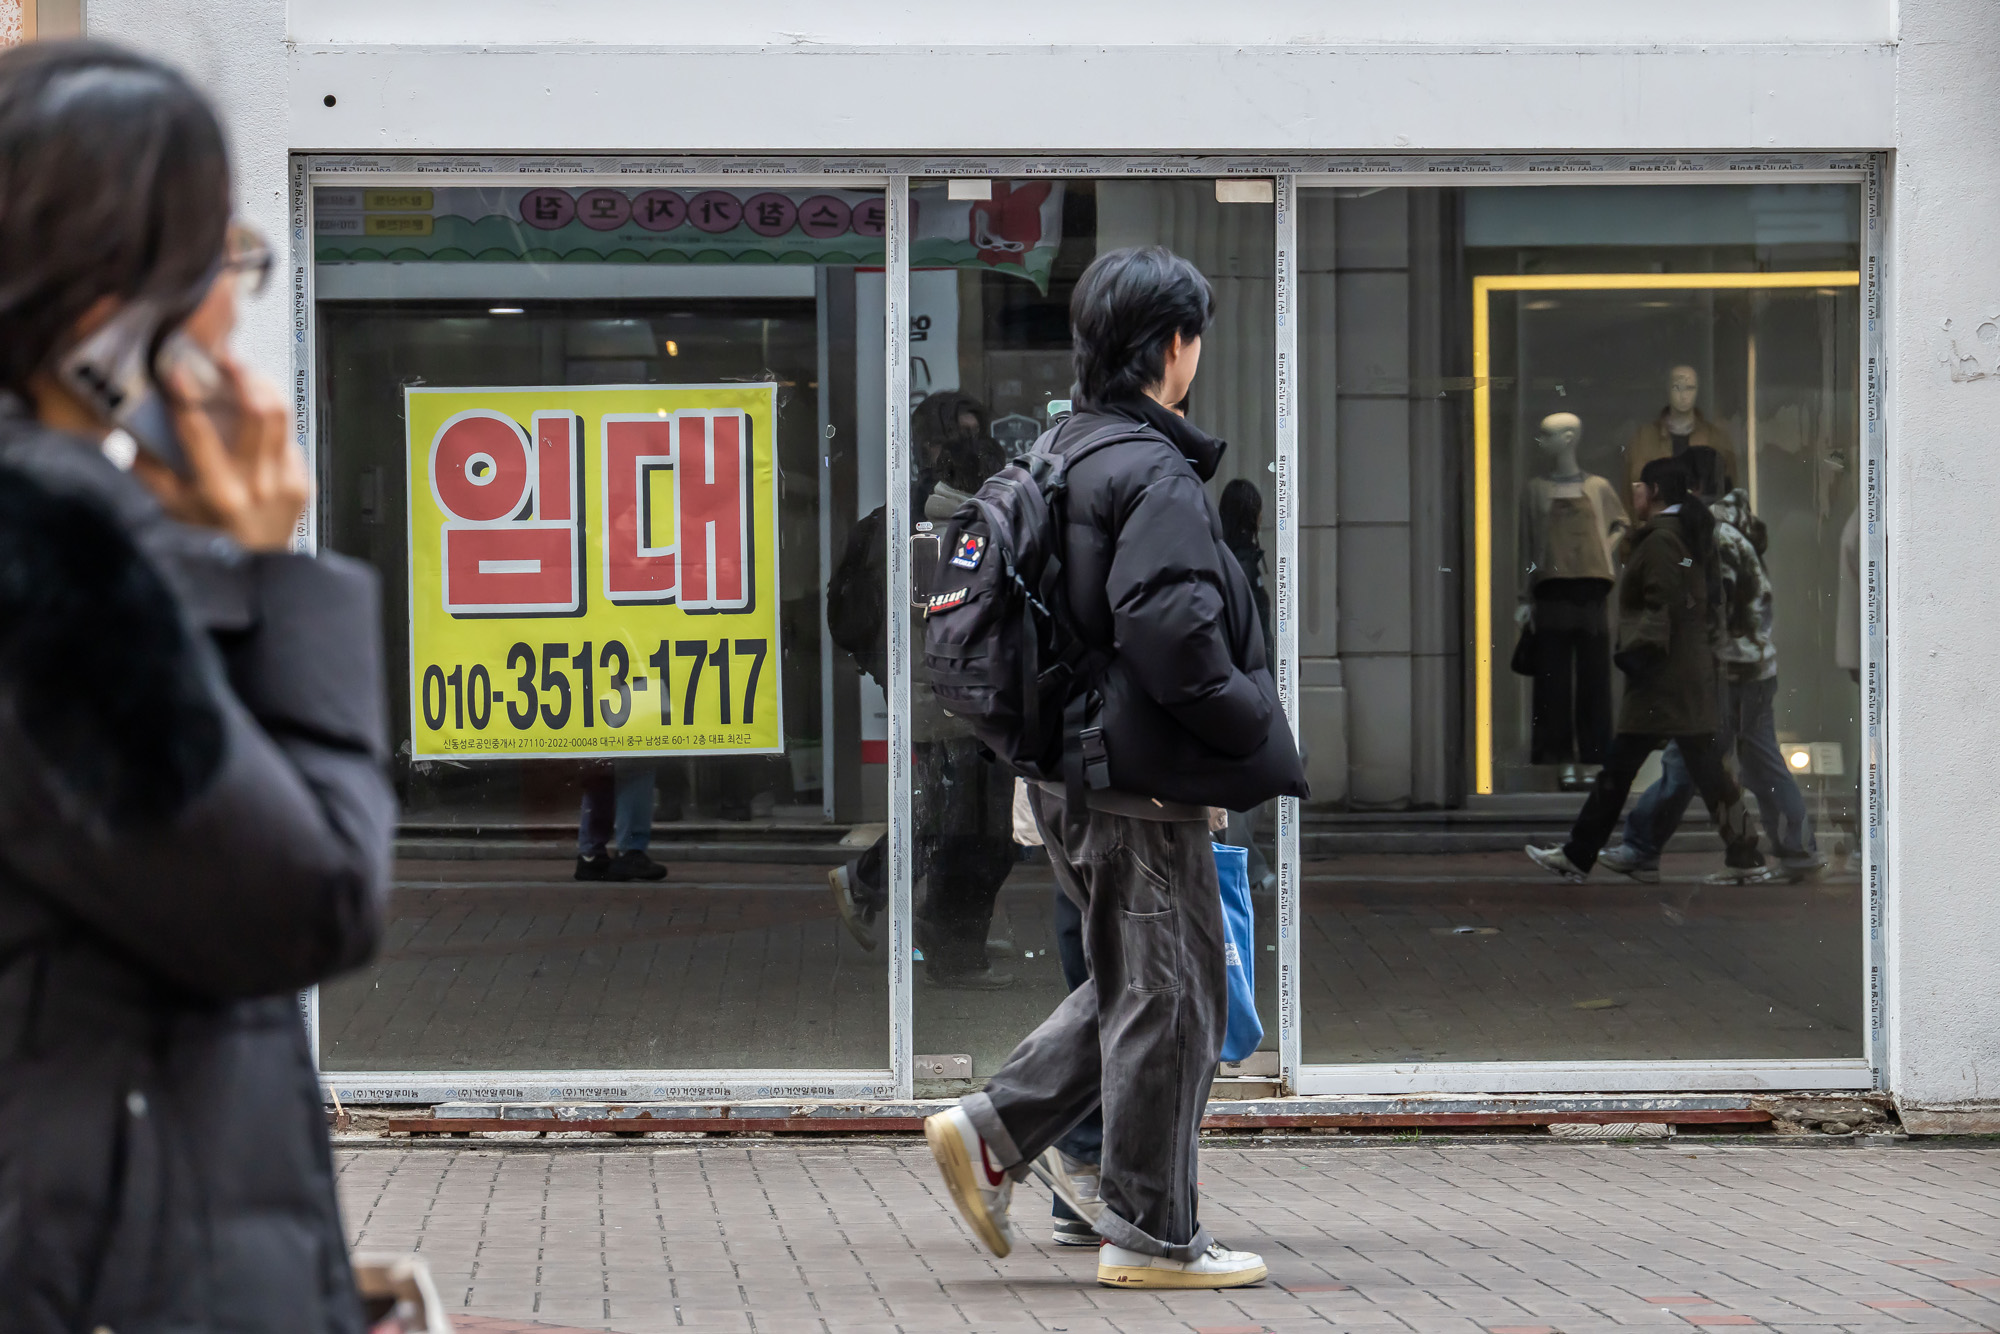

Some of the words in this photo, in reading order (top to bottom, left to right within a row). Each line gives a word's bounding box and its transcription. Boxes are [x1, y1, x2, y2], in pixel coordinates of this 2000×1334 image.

[428, 408, 754, 618] 임대
[423, 639, 767, 731] 010-3513-1717
[443, 737, 516, 750] 신동성로공인중개사
[518, 737, 598, 748] 27110-2022-00048
[600, 736, 624, 747] 대구시
[627, 735, 643, 747] 중구
[645, 735, 669, 746] 남성로
[671, 735, 690, 745] 60-1
[693, 735, 706, 746] 2층
[708, 734, 725, 745] 대표
[727, 733, 752, 745] 최진근
